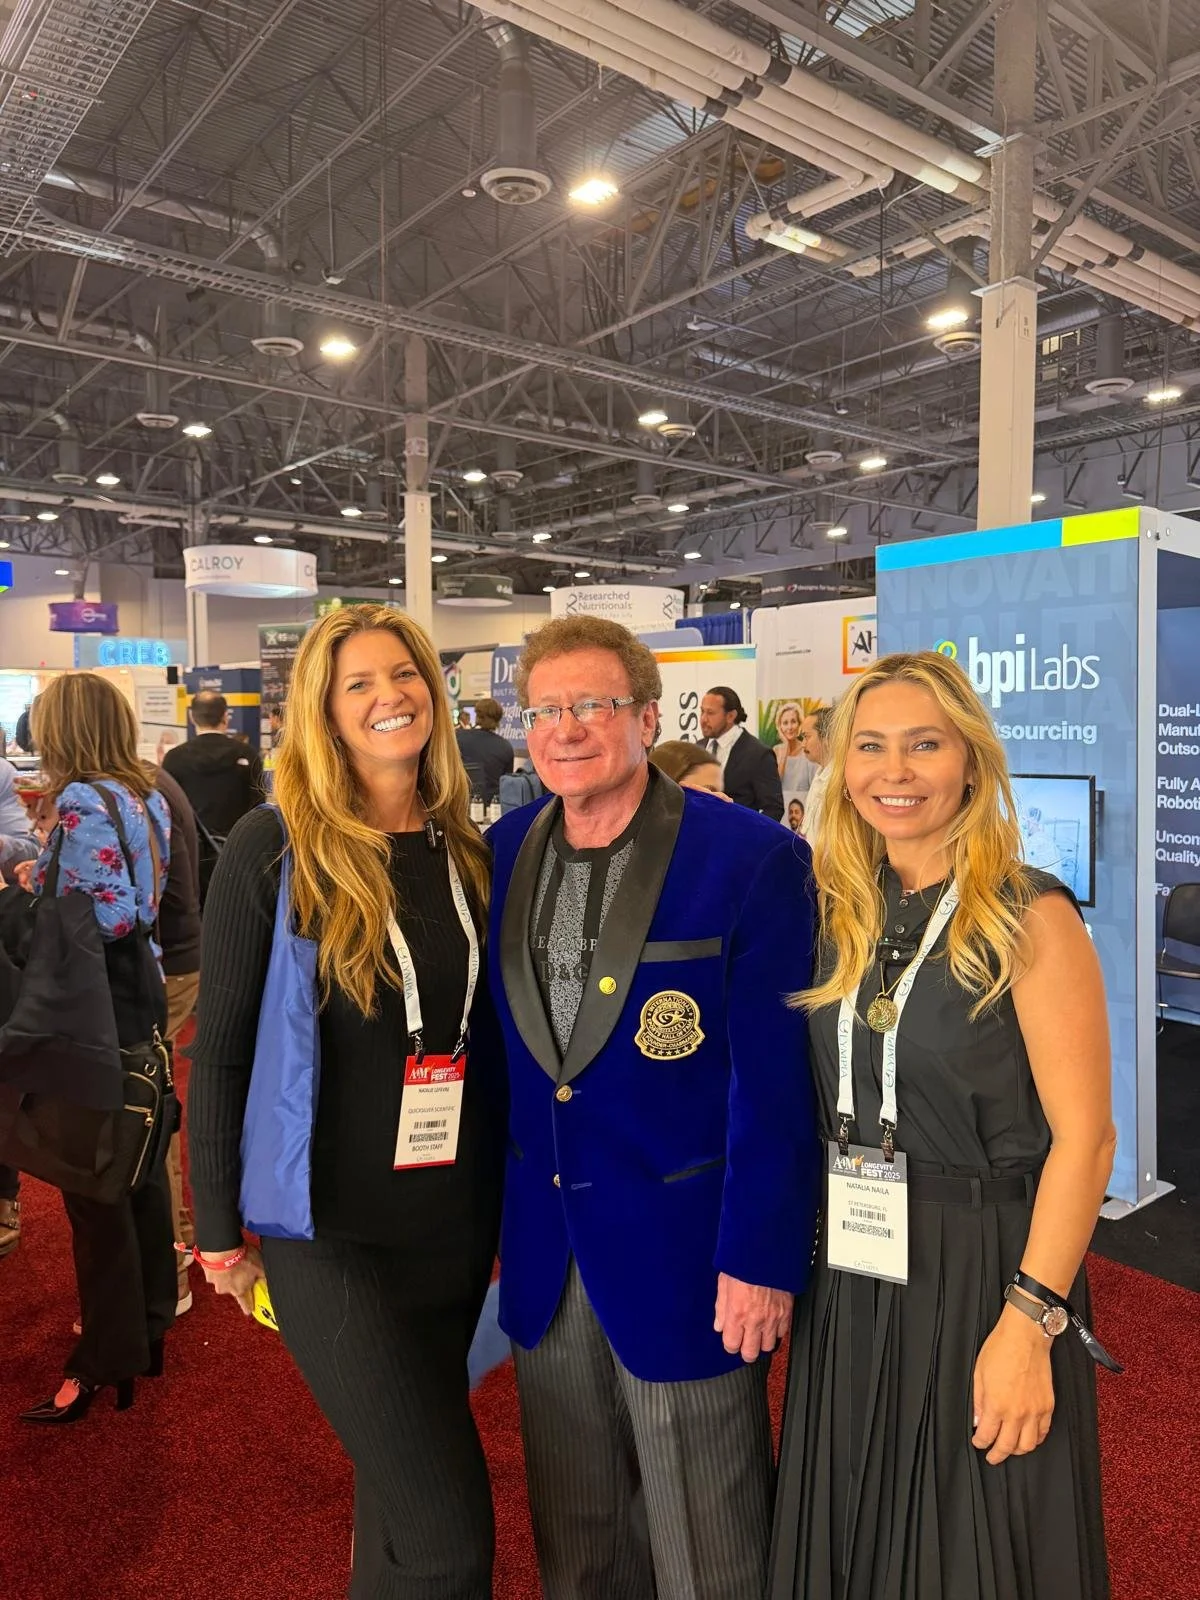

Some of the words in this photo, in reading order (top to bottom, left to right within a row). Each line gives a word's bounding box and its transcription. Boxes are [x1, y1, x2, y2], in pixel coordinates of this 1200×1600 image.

[192, 557, 243, 571] CALROY
[579, 591, 630, 601] Researched
[579, 602, 633, 611] Nutritionals
[969, 634, 1025, 708] bpi
[1031, 643, 1100, 691] Labs
[1159, 704, 1200, 717] Dual-L
[1158, 777, 1188, 793] Fully
[431, 1073, 447, 1081] FEST
[861, 1162, 894, 1170] LONGEVITY
[861, 1168, 883, 1178] FEST
[884, 1171, 901, 1180] 2025
[846, 1182, 870, 1192] NATALIA
[871, 1186, 890, 1195] NAILA
